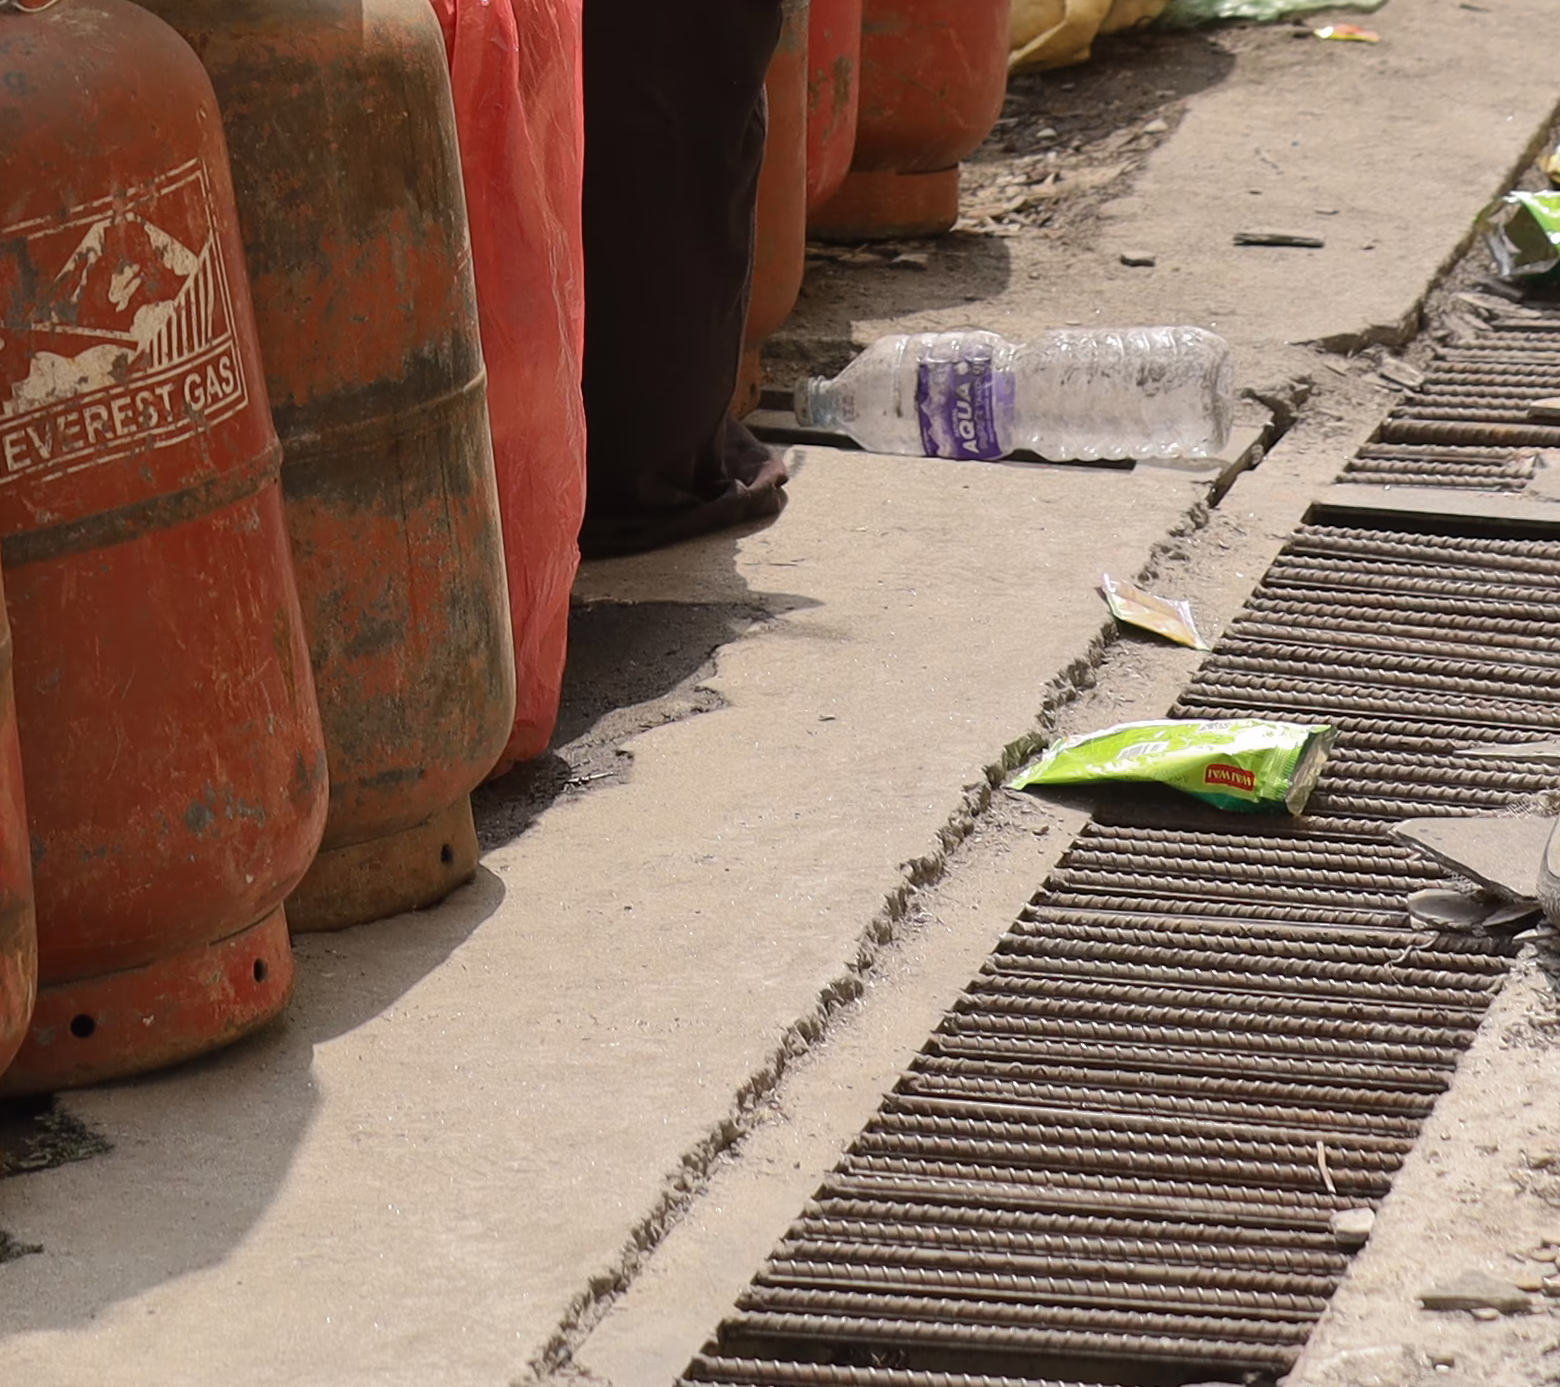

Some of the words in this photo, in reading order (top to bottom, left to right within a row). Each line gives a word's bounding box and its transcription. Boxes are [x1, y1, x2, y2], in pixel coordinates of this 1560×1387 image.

[2, 384, 175, 472] EVEREST
[183, 354, 235, 412] GAS
[956, 381, 980, 454] AQUA
